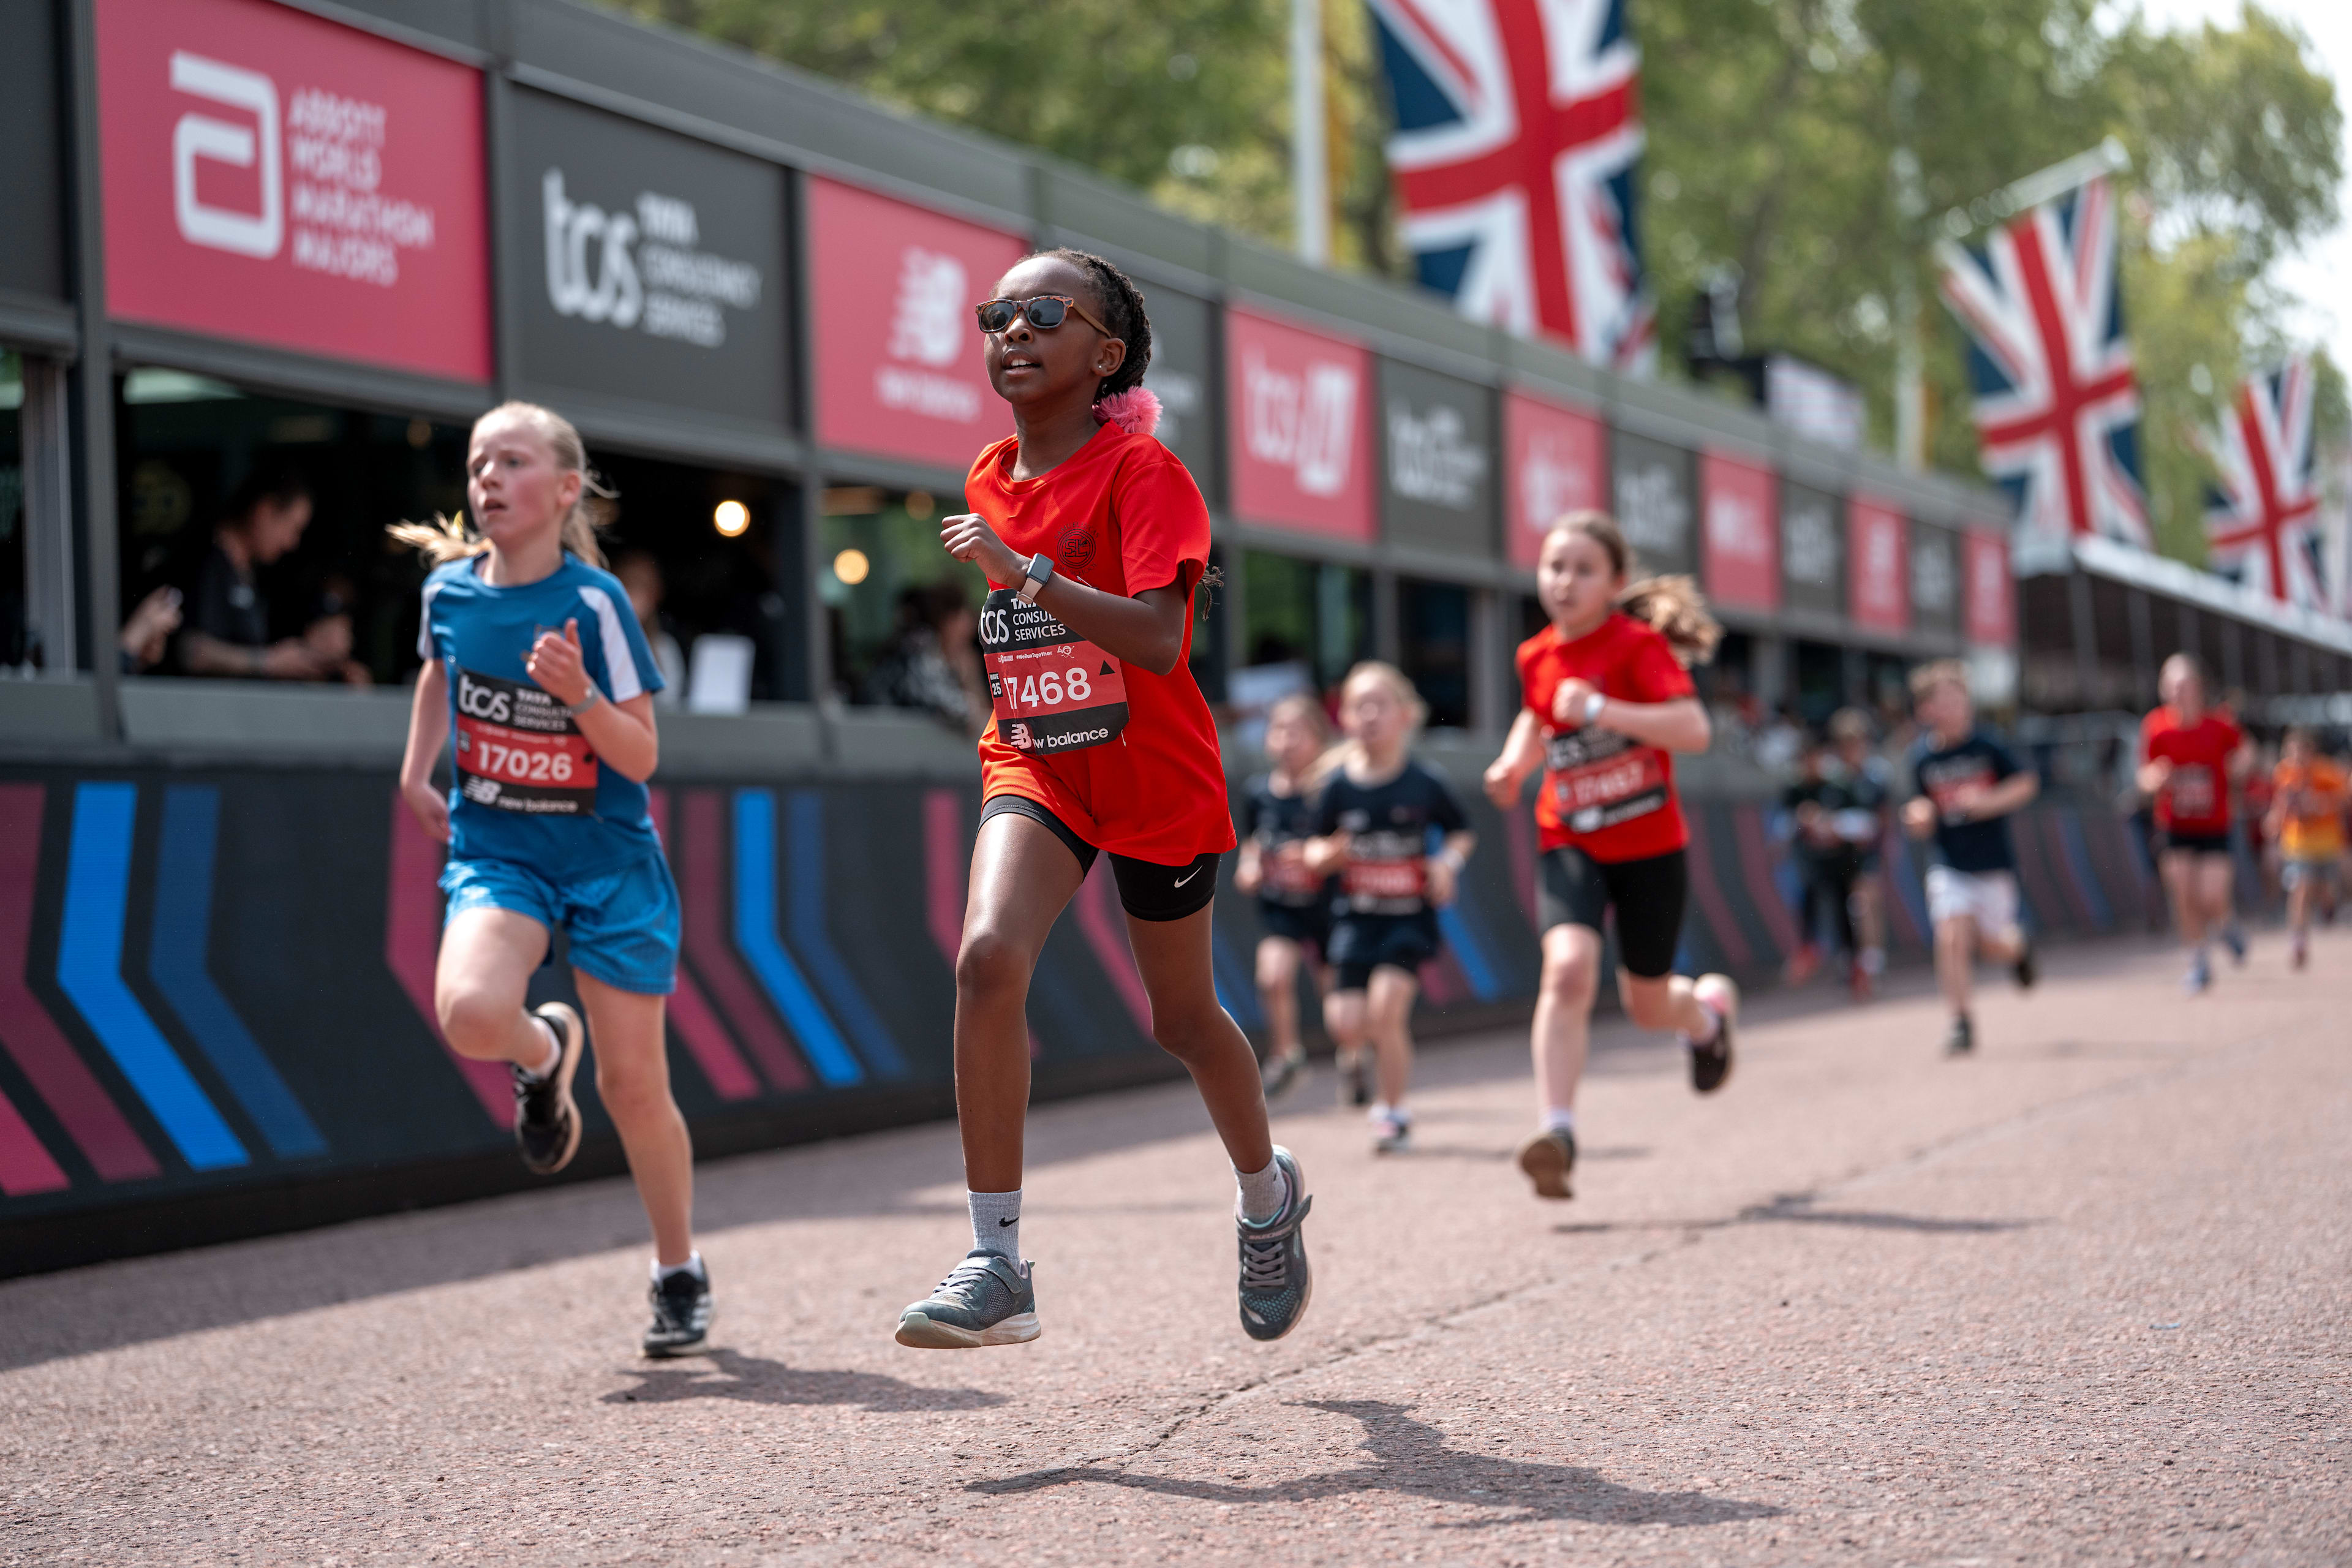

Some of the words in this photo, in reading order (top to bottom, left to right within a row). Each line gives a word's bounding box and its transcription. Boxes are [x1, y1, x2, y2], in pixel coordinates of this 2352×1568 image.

[289, 136, 381, 191] WORLD
[291, 184, 435, 247] MARATHON
[543, 167, 642, 329] tcs
[292, 230, 398, 288] MAJORS
[1011, 598, 1037, 610] TA
[980, 607, 1009, 645] tcs
[1012, 610, 1057, 625] CONSUL
[1014, 624, 1066, 641] SERVICES
[1016, 651, 1052, 660] #WeRunTogether
[458, 674, 510, 722] tcs
[516, 688, 552, 706] TATA
[992, 682, 1002, 695] 25
[513, 715, 567, 731] SERVICES
[1047, 728, 1109, 748] balance
[478, 740, 573, 782] 17026
[497, 796, 523, 810] new
[524, 797, 578, 813] balance
